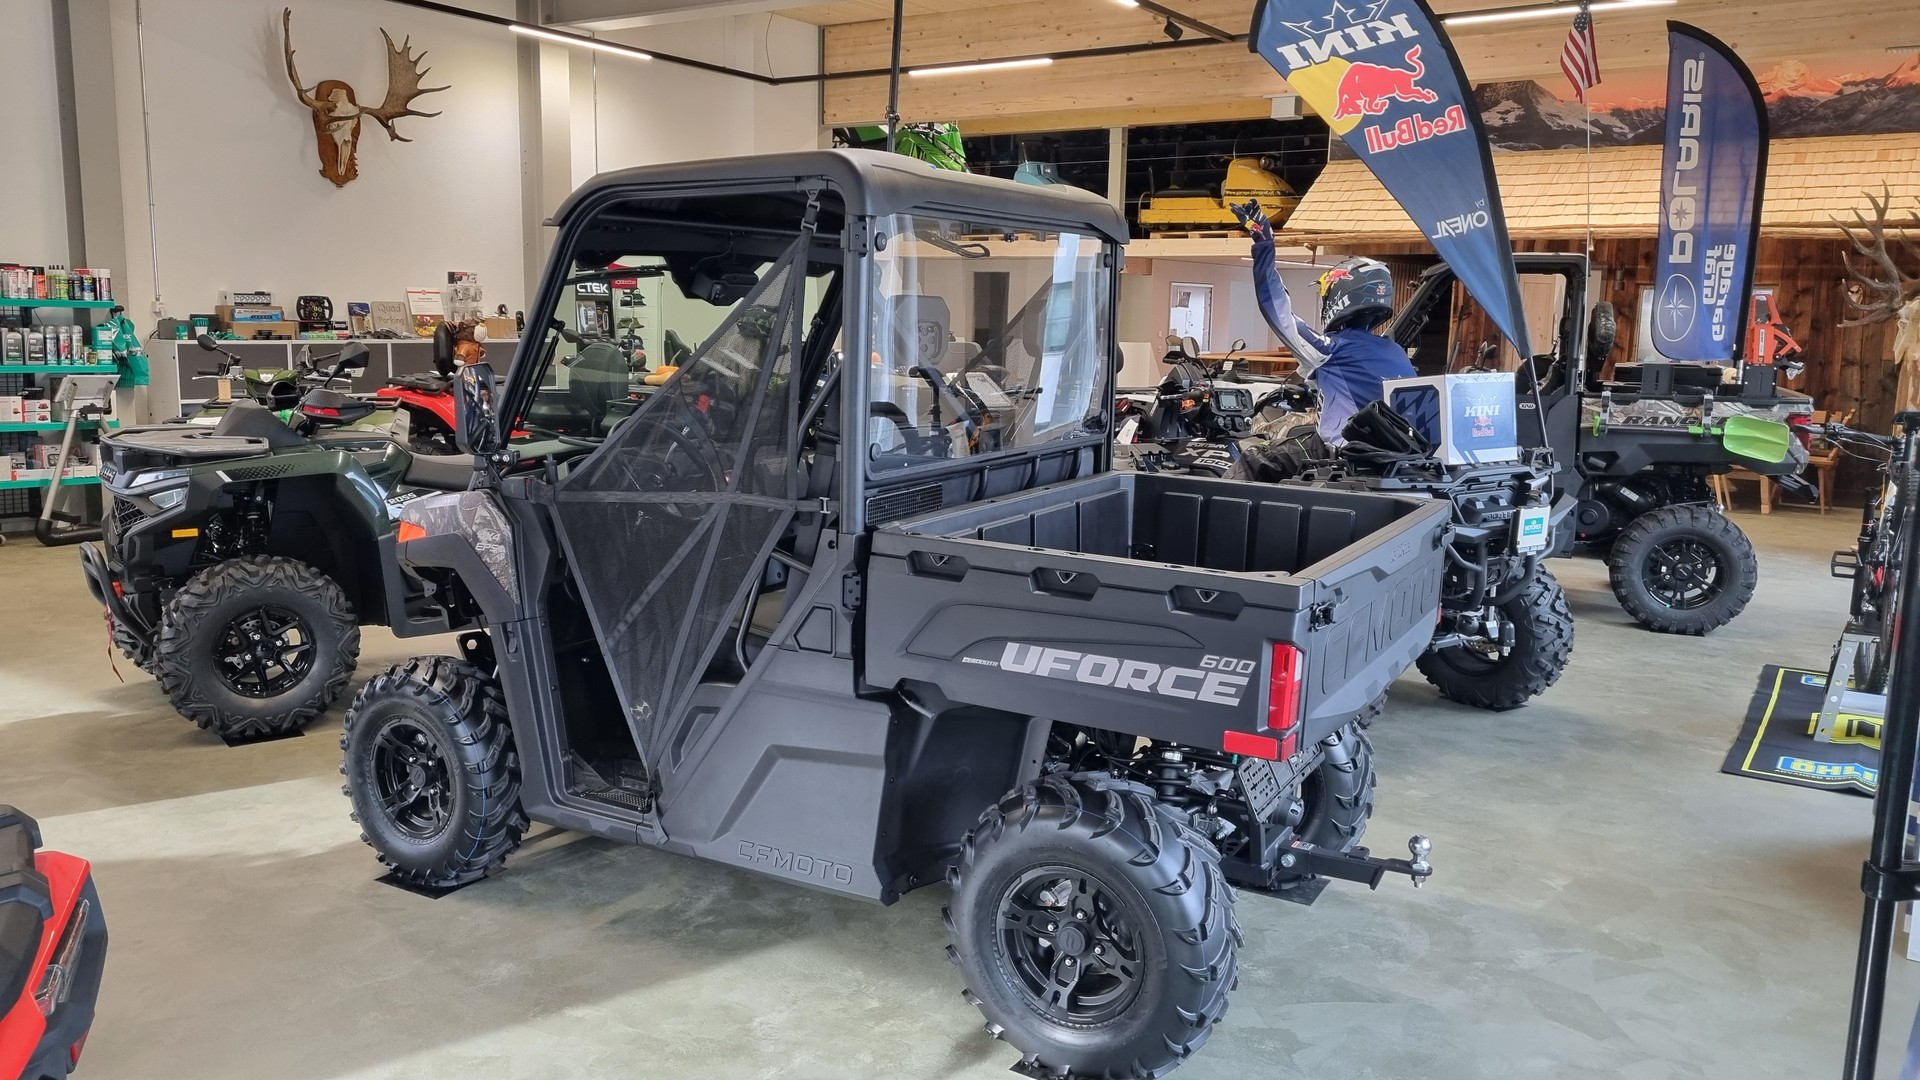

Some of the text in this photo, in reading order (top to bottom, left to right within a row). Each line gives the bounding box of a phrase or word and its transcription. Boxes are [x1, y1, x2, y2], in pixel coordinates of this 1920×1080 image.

[576, 282, 609, 294] CTEK
[377, 303, 401, 313] Quad
[378, 316, 405, 327] Parking
[1464, 404, 1500, 417] KINI
[1178, 447, 1231, 458] XP
[1200, 654, 1256, 673] 600
[999, 642, 1250, 707] UFORCE
[737, 840, 853, 886] CFMOTO
